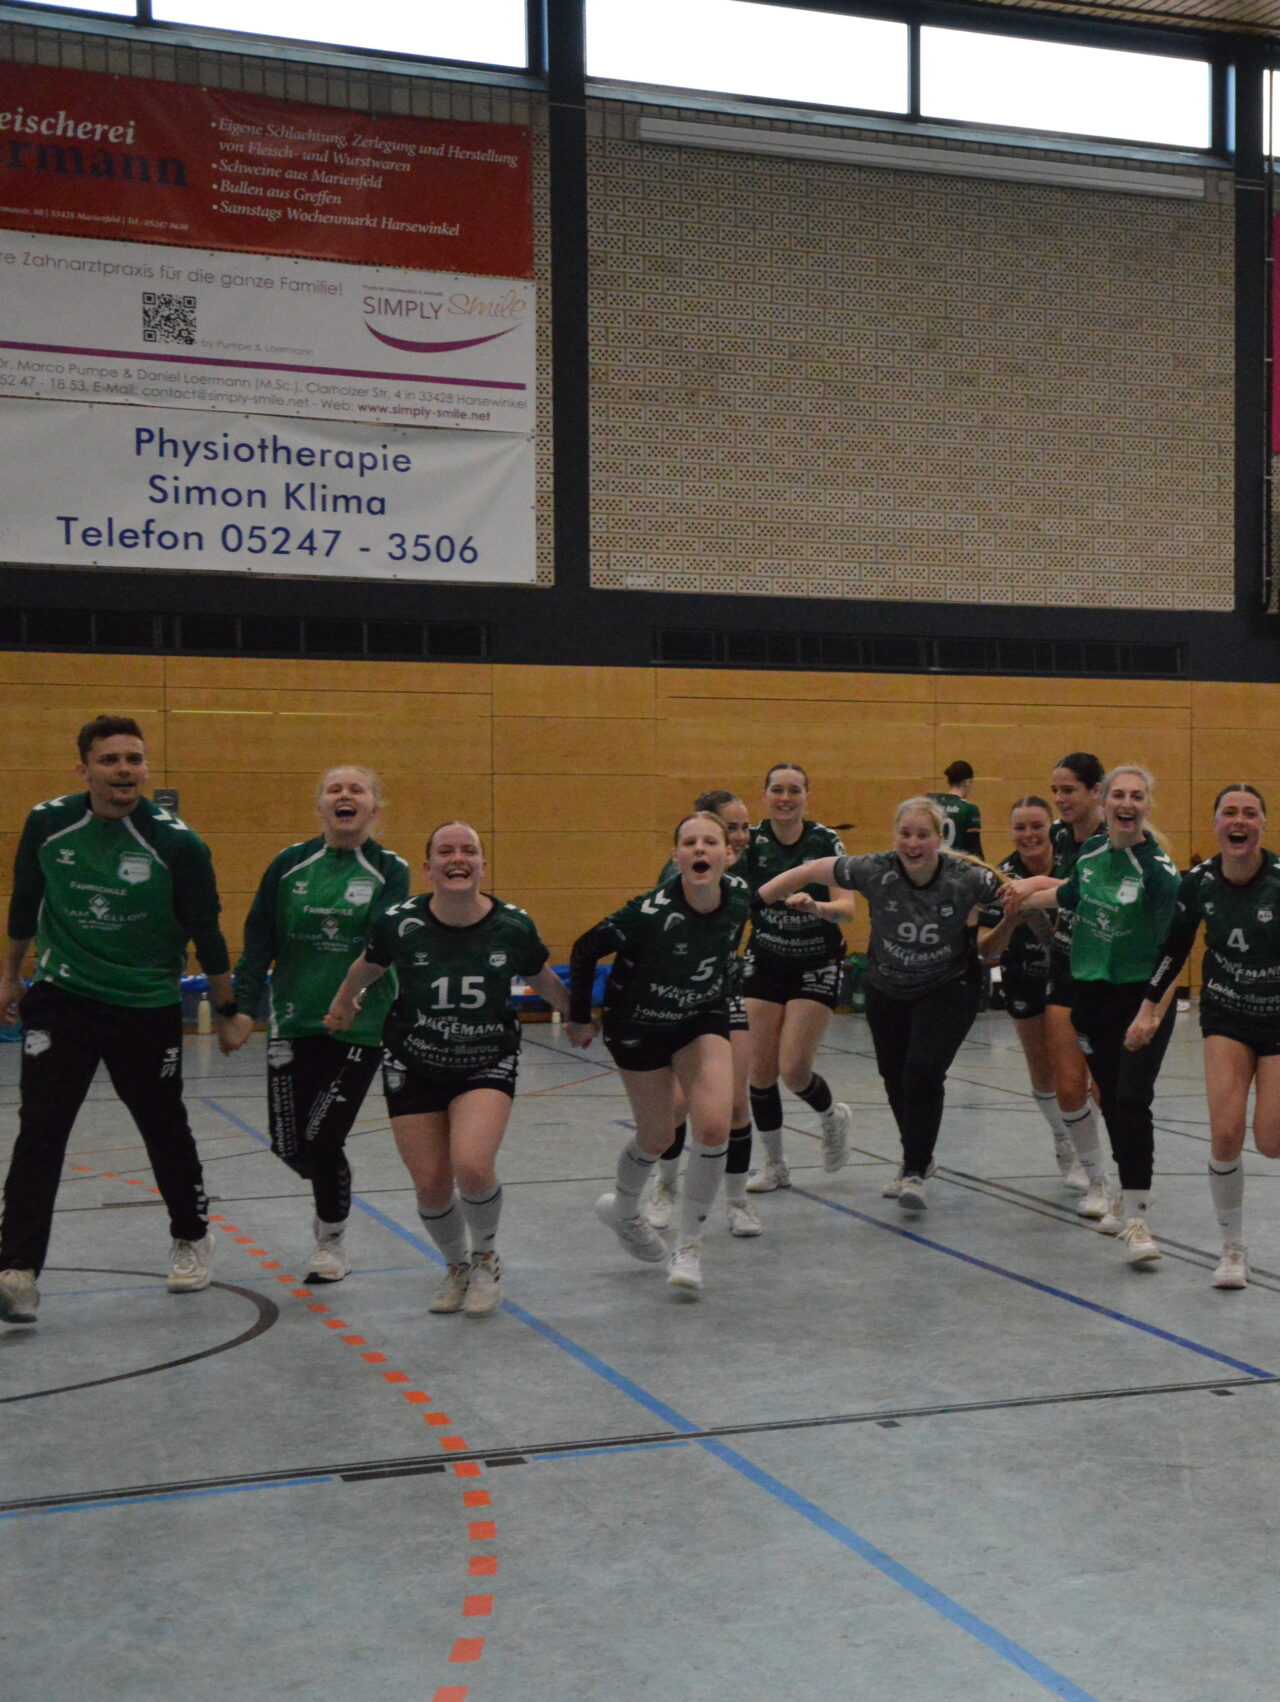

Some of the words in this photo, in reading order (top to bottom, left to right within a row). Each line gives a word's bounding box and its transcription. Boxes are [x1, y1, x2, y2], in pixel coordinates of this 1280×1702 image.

[219, 118, 262, 135] Eigene
[266, 124, 348, 148] Schlachtung,
[352, 134, 416, 156] Zerlegung
[419, 144, 444, 157] und
[448, 145, 518, 168] Herstellung
[219, 141, 243, 153] von
[248, 142, 298, 158] Fleisch-
[302, 150, 328, 163] und
[333, 152, 411, 172] Wurstwaren
[219, 159, 282, 178] Schweine
[285, 170, 308, 182] aus
[311, 169, 382, 190] Marienfeld
[220, 180, 263, 196] Bullen
[267, 189, 290, 200] aus
[294, 188, 341, 207] Greffen
[220, 200, 282, 222] Samstags
[287, 207, 377, 228] Wochenmarkt
[381, 217, 460, 236] Harsewinkel
[23, 251, 154, 278] Zahnarztpraxis
[160, 265, 182, 281] für
[187, 269, 215, 284] die
[220, 273, 274, 289] ganze
[280, 277, 343, 296] Familie!
[363, 296, 443, 320] SIMPLY
[448, 289, 527, 321] Smile
[17, 360, 64, 374] Marco
[69, 363, 118, 379] Pumpe
[122, 369, 133, 378] &
[137, 368, 180, 383] Daniel
[184, 373, 250, 388] Loermann
[373, 387, 391, 399] Str.
[405, 389, 416, 400] in
[419, 391, 454, 404] 33428
[457, 394, 528, 409] Harsewinkel
[320, 398, 353, 412] Web:
[357, 403, 490, 421] www.simply-smile.net
[135, 427, 413, 477] Physiotherapie
[149, 475, 267, 508] Simon
[284, 483, 387, 516] Klima
[57, 516, 204, 551] Telefon
[221, 525, 341, 558] 05247
[388, 533, 479, 564] 3506
[897, 922, 940, 944] 96
[1227, 928, 1249, 952] 4
[690, 957, 717, 981] 5
[430, 976, 487, 1009] 15
